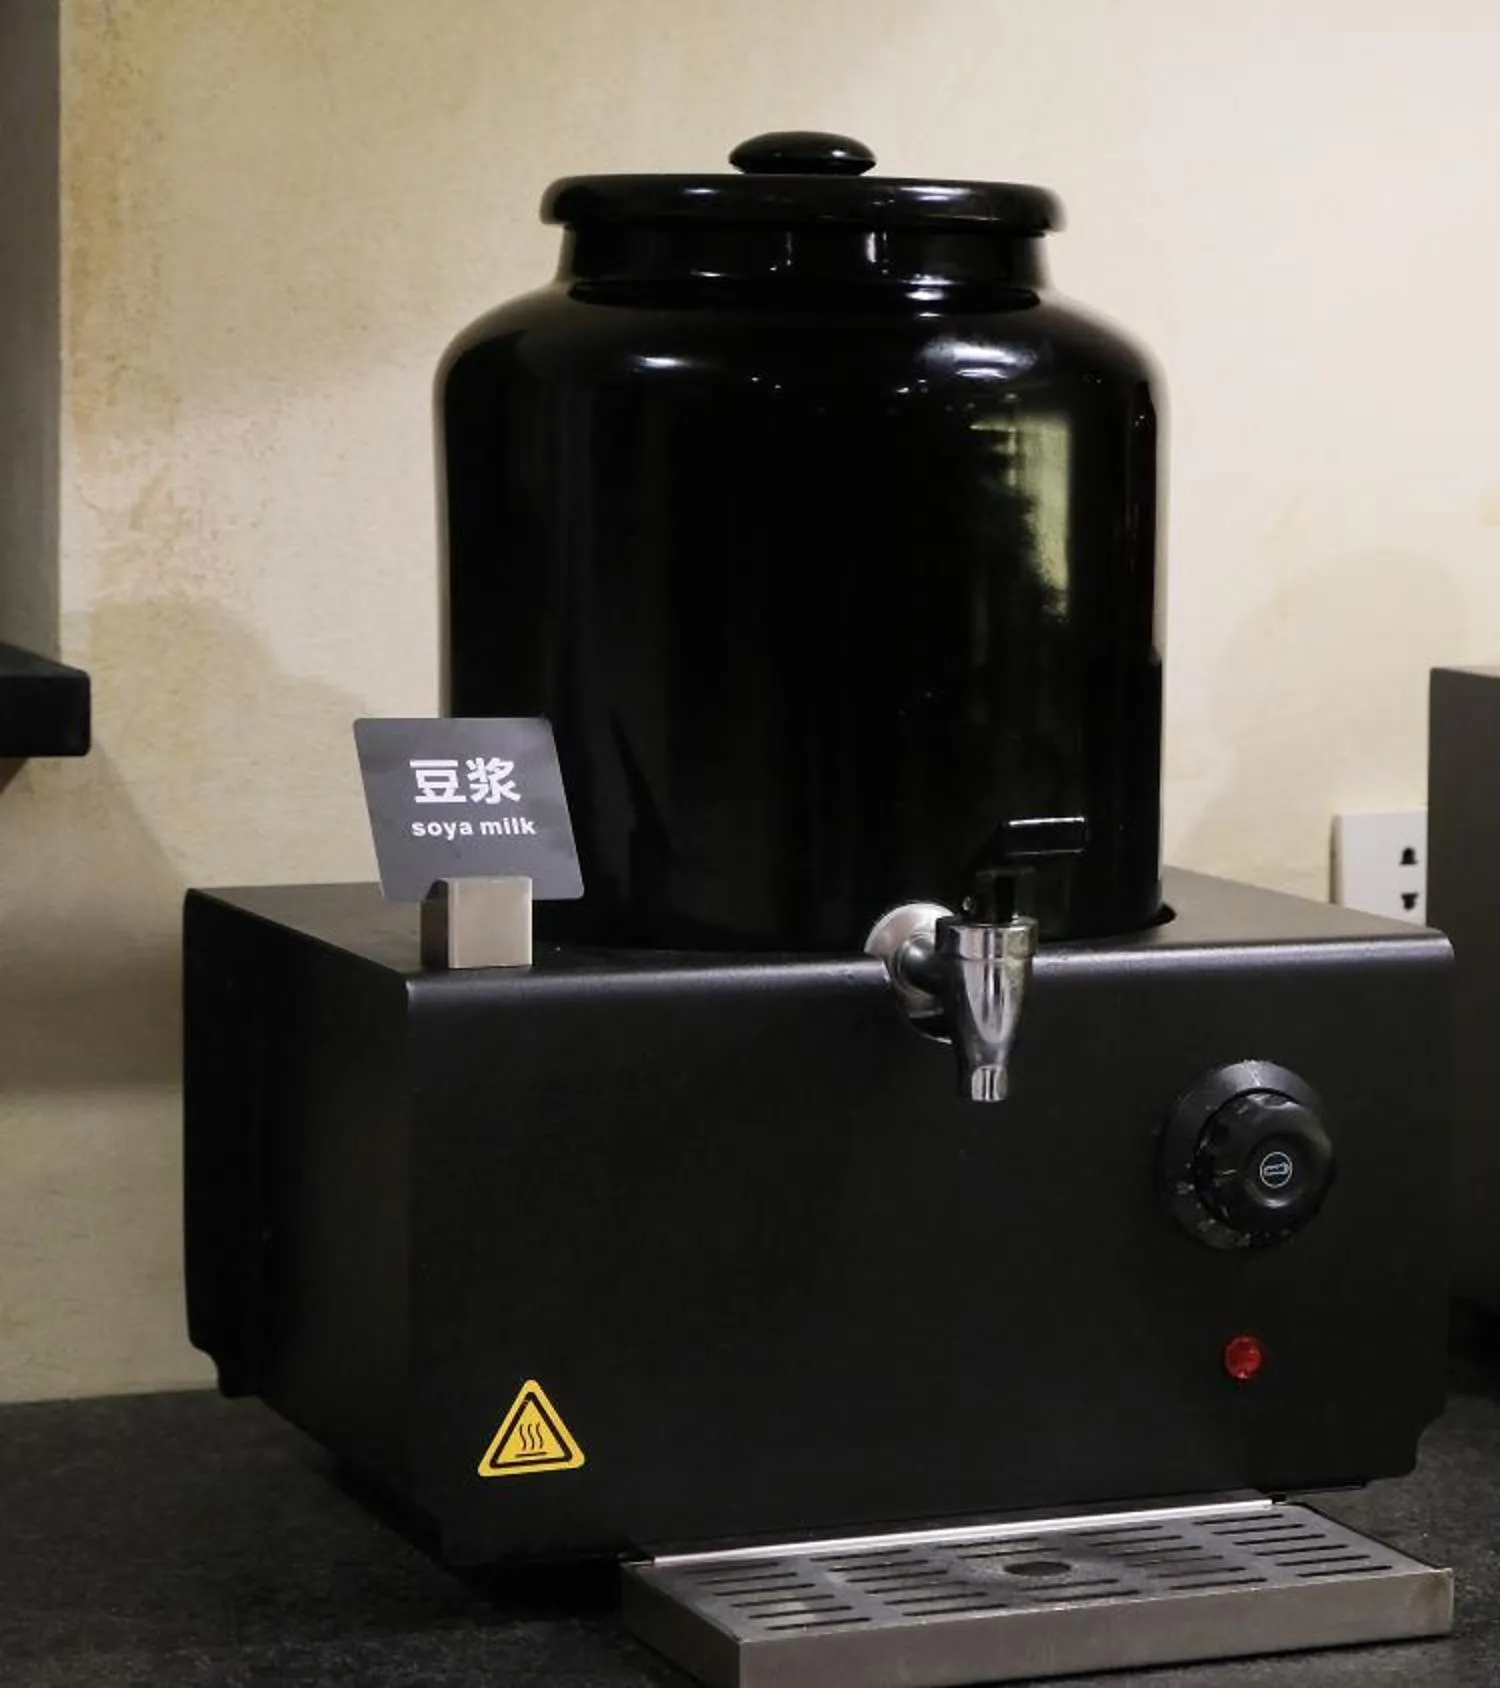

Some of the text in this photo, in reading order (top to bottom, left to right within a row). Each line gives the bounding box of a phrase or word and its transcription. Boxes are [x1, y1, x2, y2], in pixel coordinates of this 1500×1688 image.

[409, 757, 522, 804] 豆浆
[411, 817, 537, 841] soya milk
